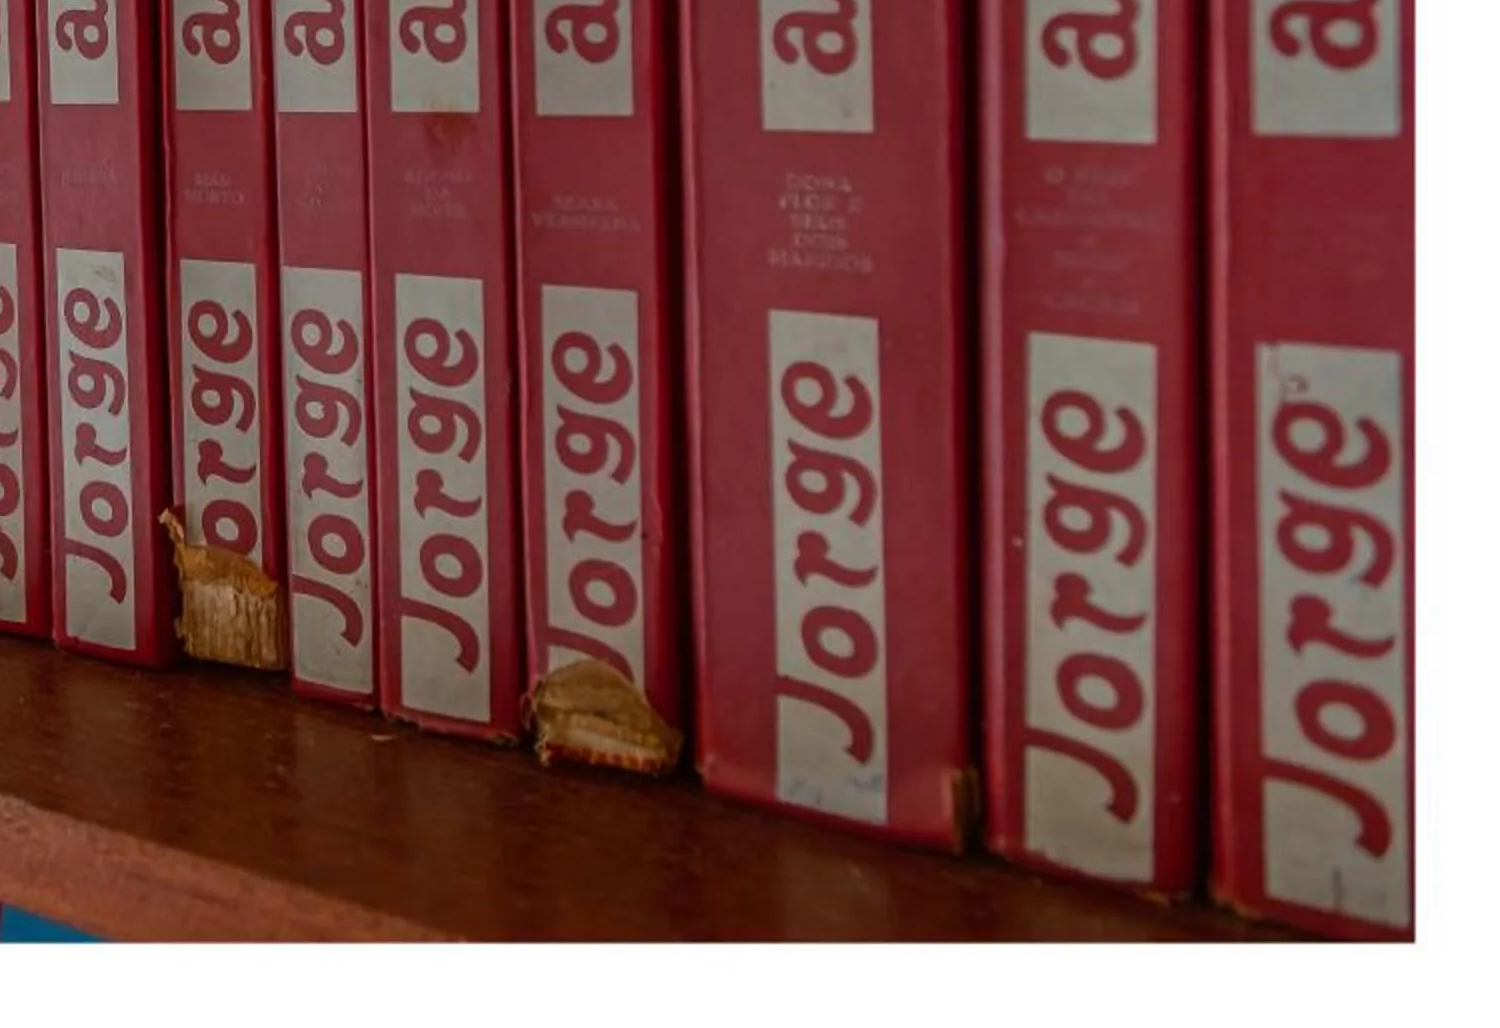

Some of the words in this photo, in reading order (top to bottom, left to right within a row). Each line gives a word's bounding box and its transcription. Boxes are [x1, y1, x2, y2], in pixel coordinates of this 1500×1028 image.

[64, 287, 129, 604] Jorge
[188, 299, 258, 555] orge
[290, 308, 365, 646] Jorge
[400, 318, 482, 673] Jorge
[776, 361, 879, 765] Jorge
[1025, 389, 1149, 825] Jorge
[1261, 401, 1396, 859] Jorge
